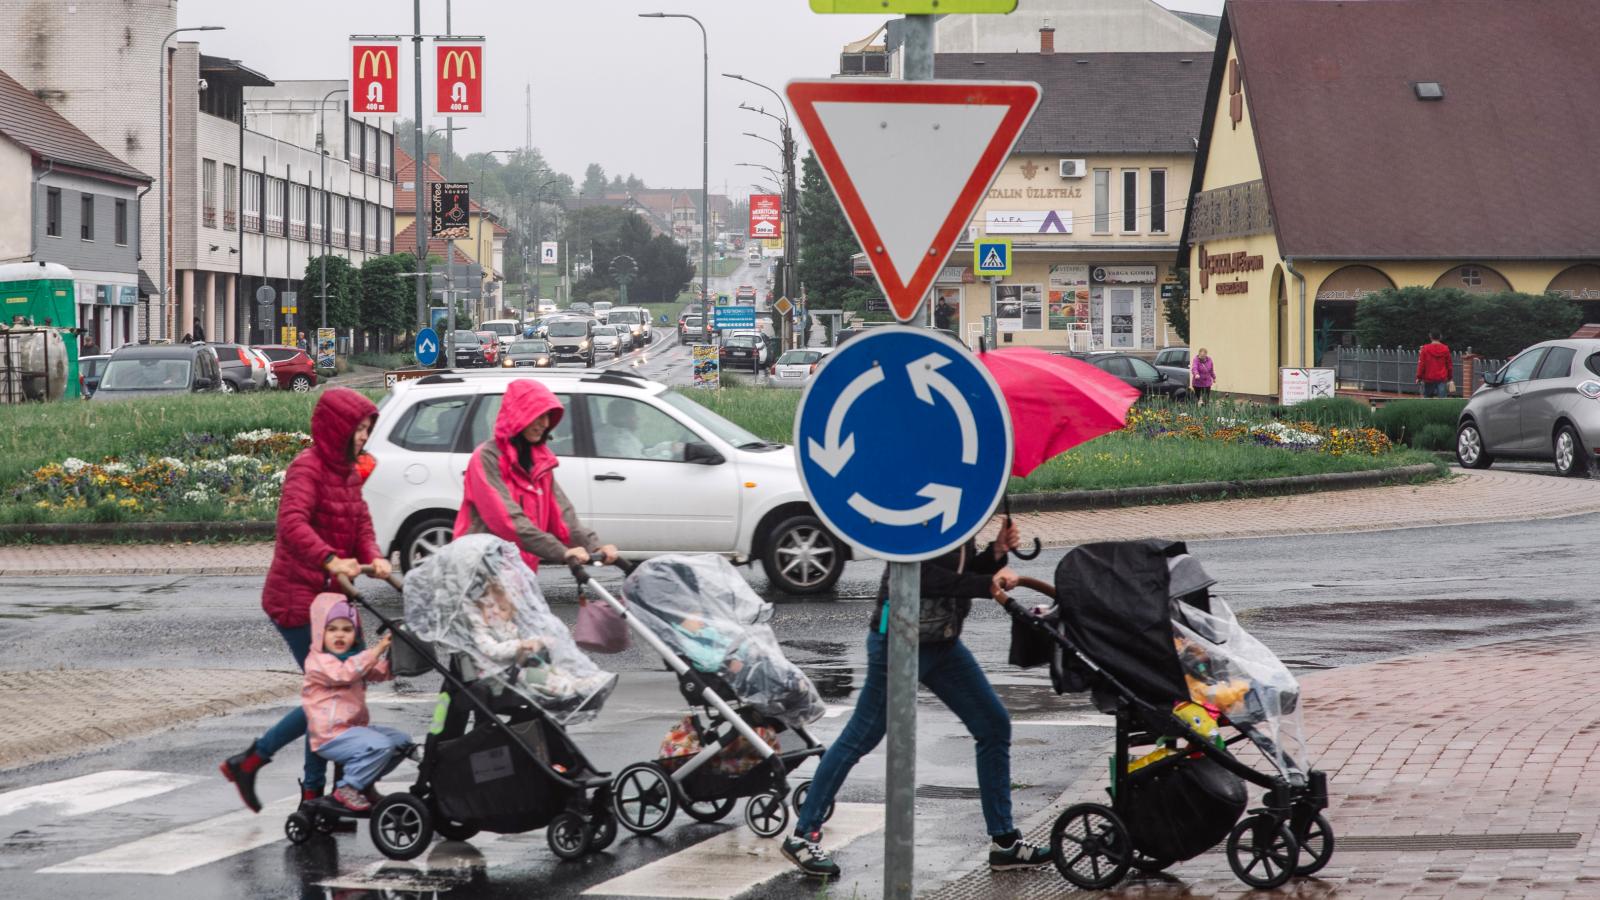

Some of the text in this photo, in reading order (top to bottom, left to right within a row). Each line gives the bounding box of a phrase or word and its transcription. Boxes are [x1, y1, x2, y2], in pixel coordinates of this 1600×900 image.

[366, 103, 378, 111] 400
[450, 103, 462, 111] 400
[1026, 186, 1082, 199] ÜZLETHÁZ
[433, 183, 442, 231] bar coffee
